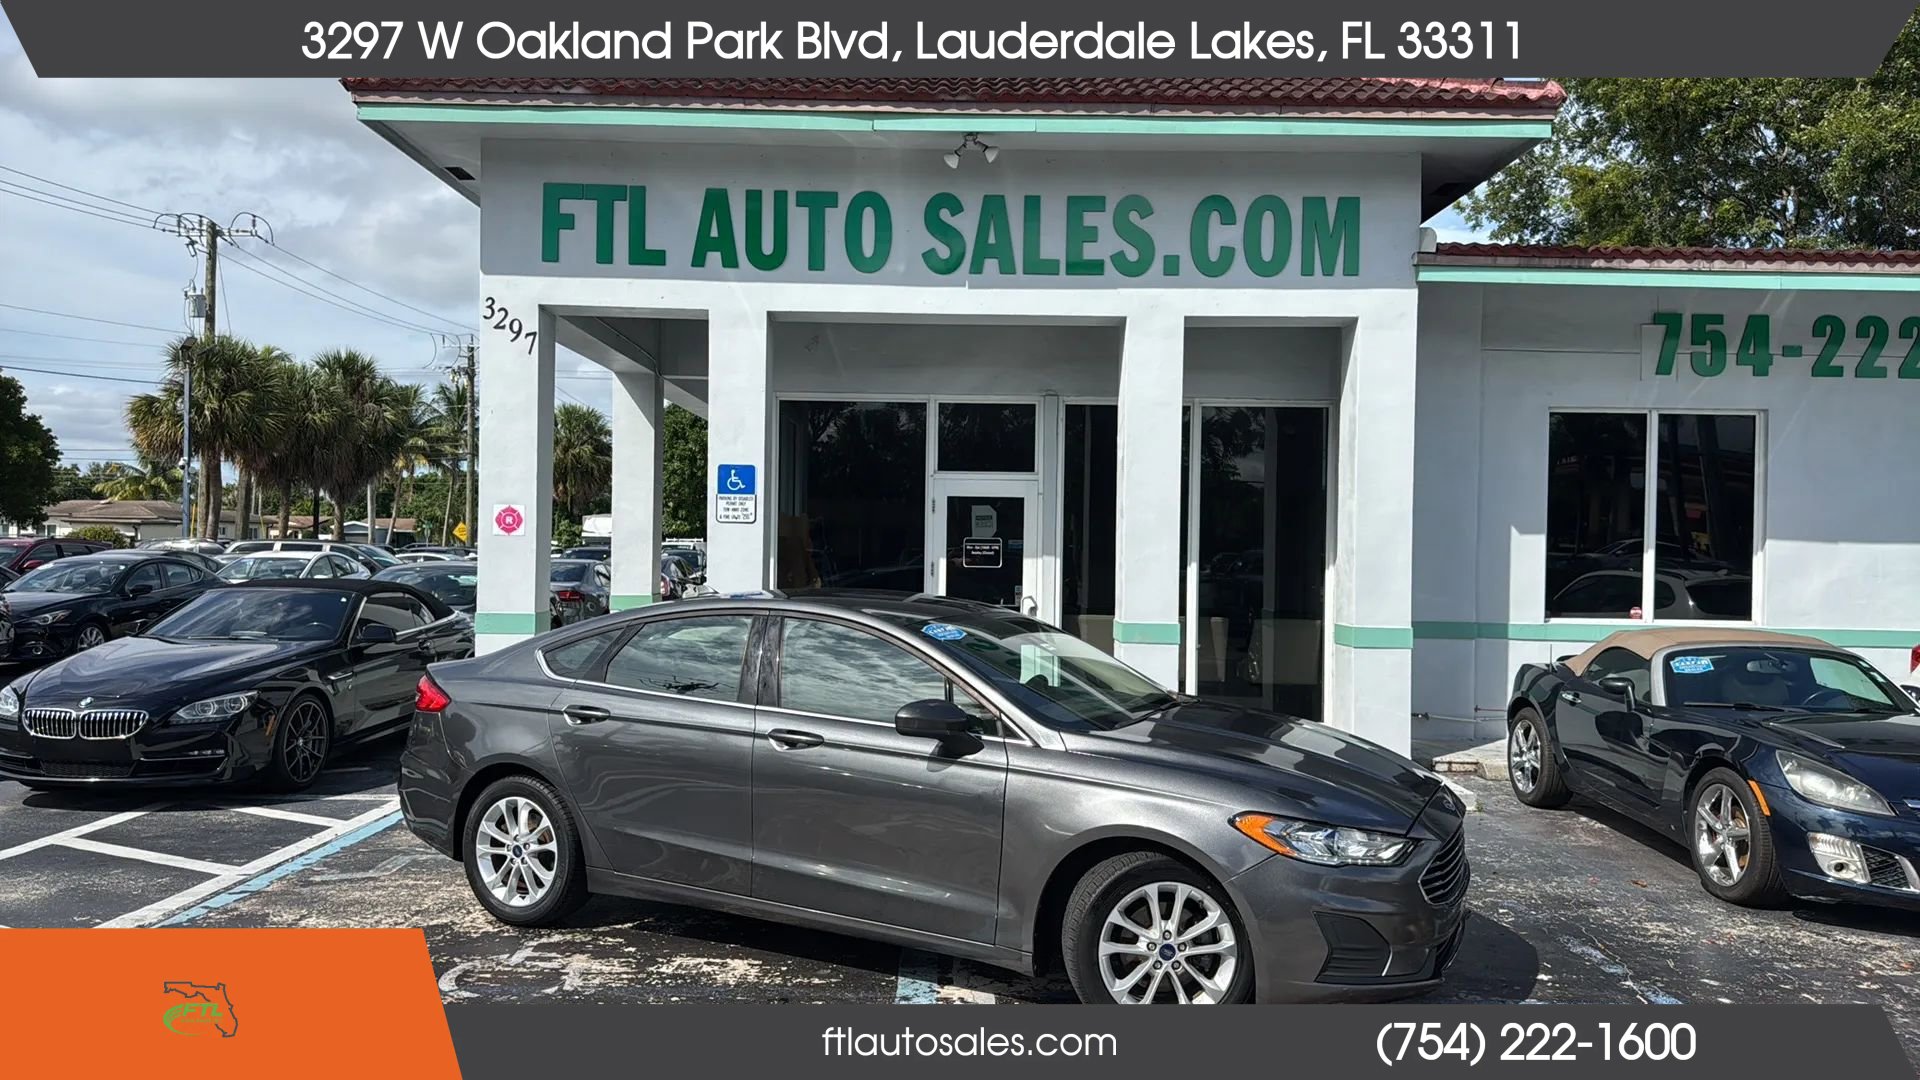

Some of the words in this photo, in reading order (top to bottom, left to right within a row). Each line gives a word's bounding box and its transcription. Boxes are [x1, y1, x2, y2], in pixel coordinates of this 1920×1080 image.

[541, 182, 667, 267] FTL
[691, 188, 893, 273] AUTO
[921, 191, 1361, 278] SALES.COM
[483, 296, 538, 355] 3297
[1653, 312, 1920, 379] 754-222
[505, 515, 514, 525] R
